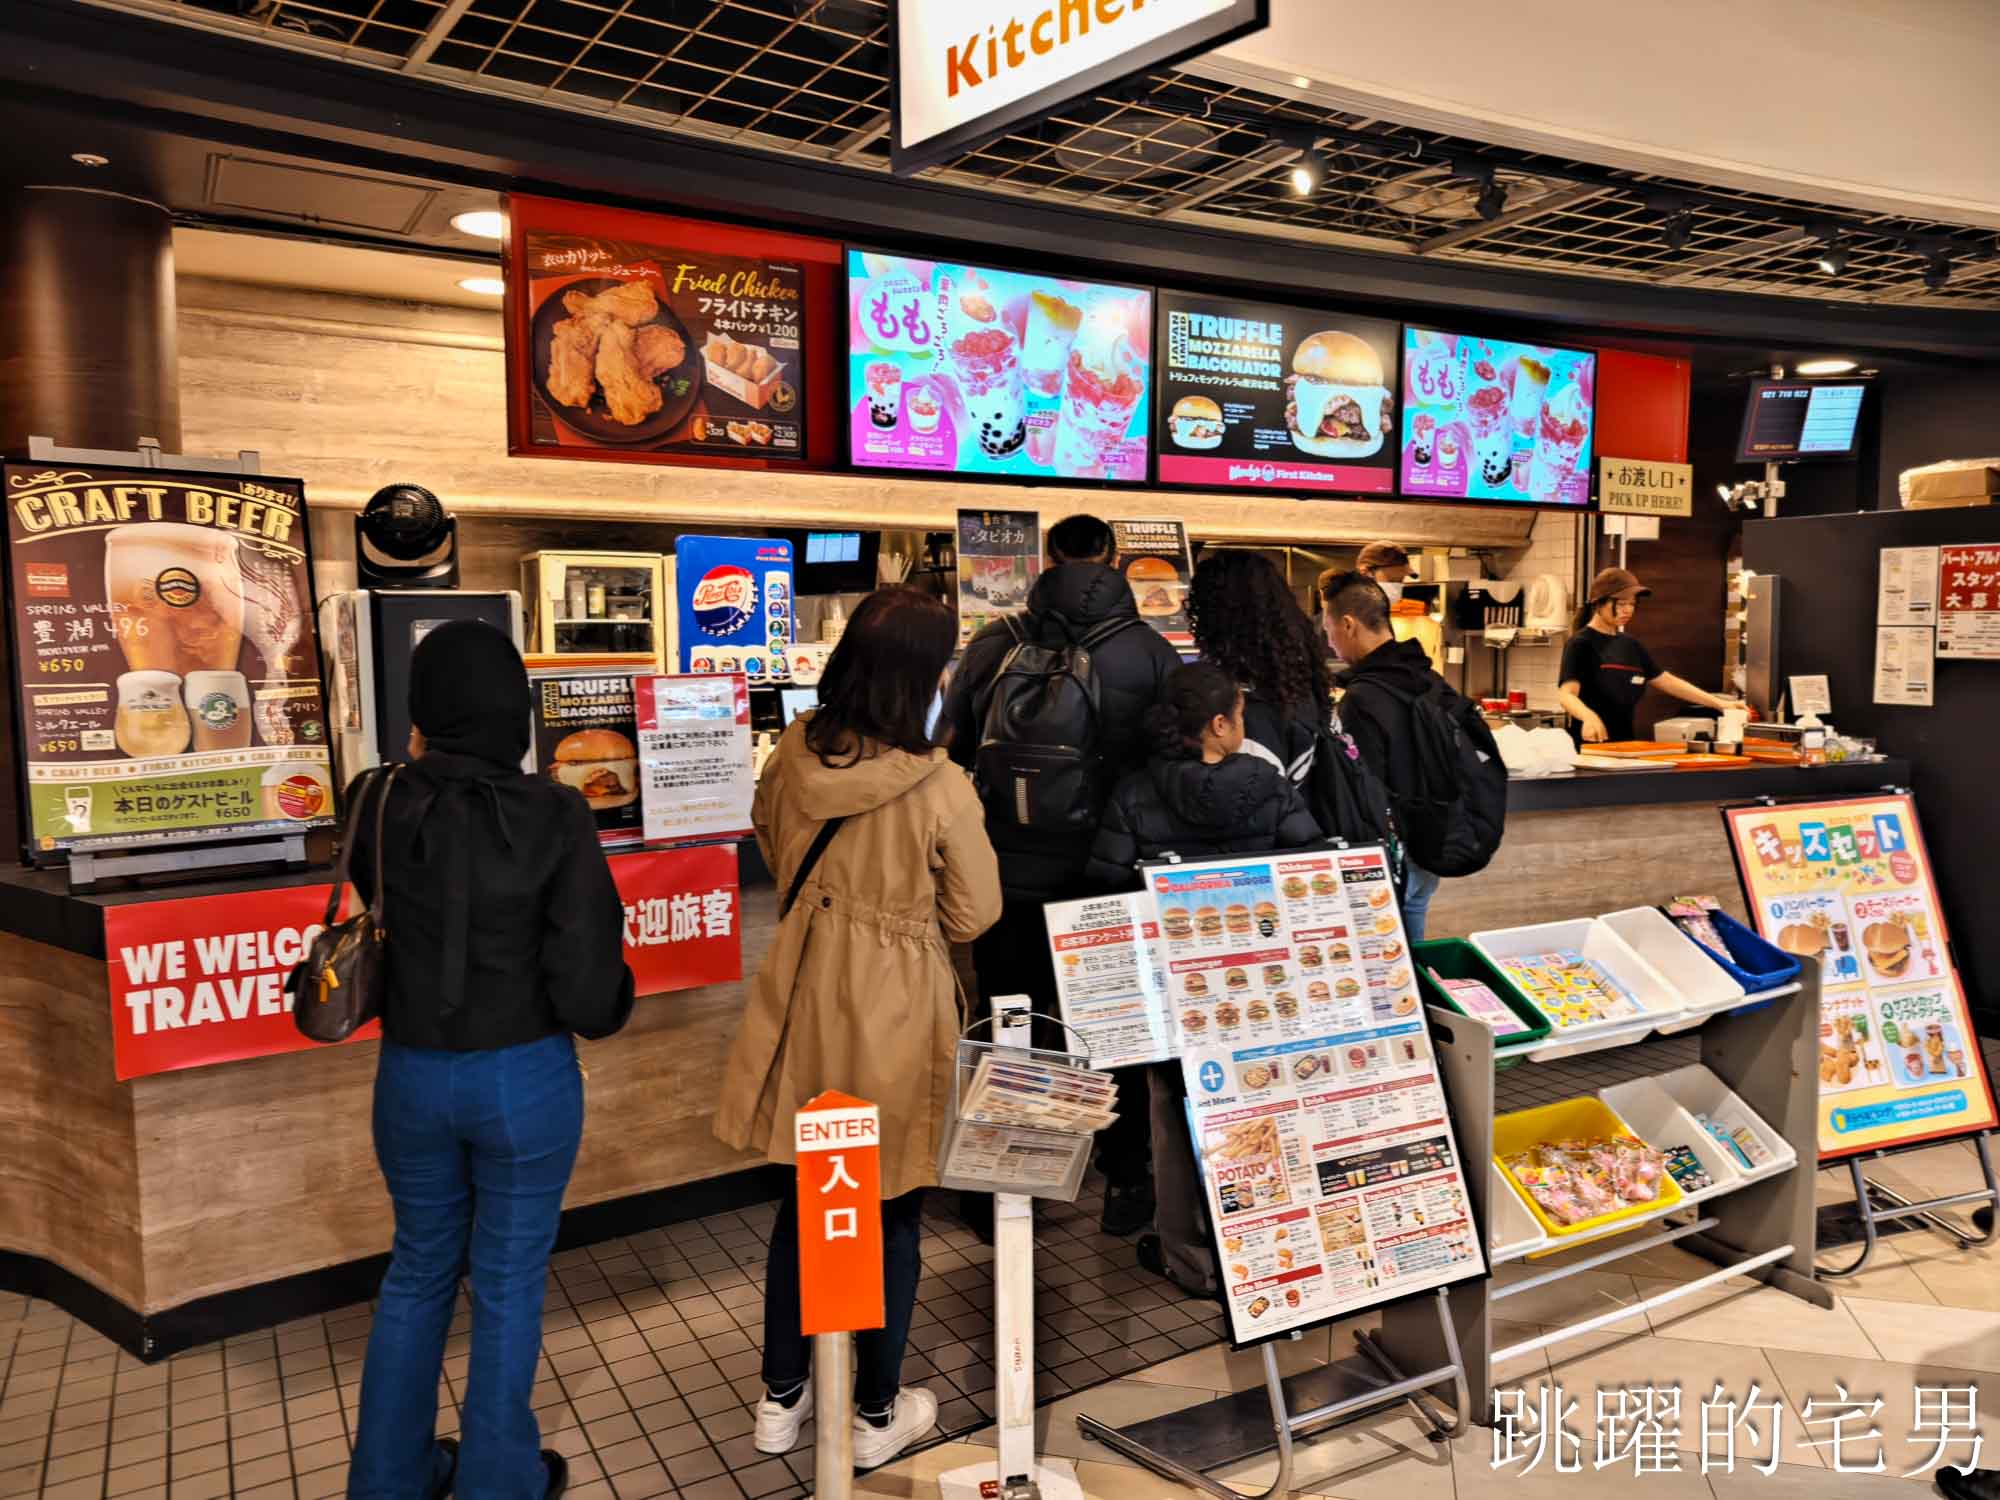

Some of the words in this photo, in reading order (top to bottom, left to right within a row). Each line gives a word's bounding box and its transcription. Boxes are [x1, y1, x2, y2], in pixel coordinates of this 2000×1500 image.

[947, 0, 1145, 98] Kitche
[673, 264, 727, 294] Fried
[730, 271, 798, 299] Chicken
[698, 297, 798, 322] フライドチキン
[870, 291, 931, 345] もも
[1188, 313, 1283, 346] TRUFFLE
[1188, 340, 1281, 362] MOZZARELLA
[1188, 354, 1282, 378] BACONATOR
[1618, 466, 1674, 488] お渡し口
[1608, 490, 1634, 508] PICK
[1637, 494, 1651, 509] UP
[14, 487, 168, 533] CRAFT
[185, 490, 296, 542] BEER
[1126, 523, 1177, 535] TRUFFLE
[25, 604, 77, 615] SPRING
[1945, 591, 2000, 609] 大募
[38, 658, 85, 673] ¥650
[560, 679, 631, 696] TRUFFL
[560, 704, 633, 718] BACONATO
[114, 792, 254, 814] 本日のゲストビール
[216, 806, 251, 819] ¥650
[120, 940, 187, 985] WE
[125, 972, 296, 1035] TRAVE
[800, 1118, 877, 1141] ENTER
[1215, 1161, 1267, 1182] POTATO
[820, 1155, 860, 1240] 入口
